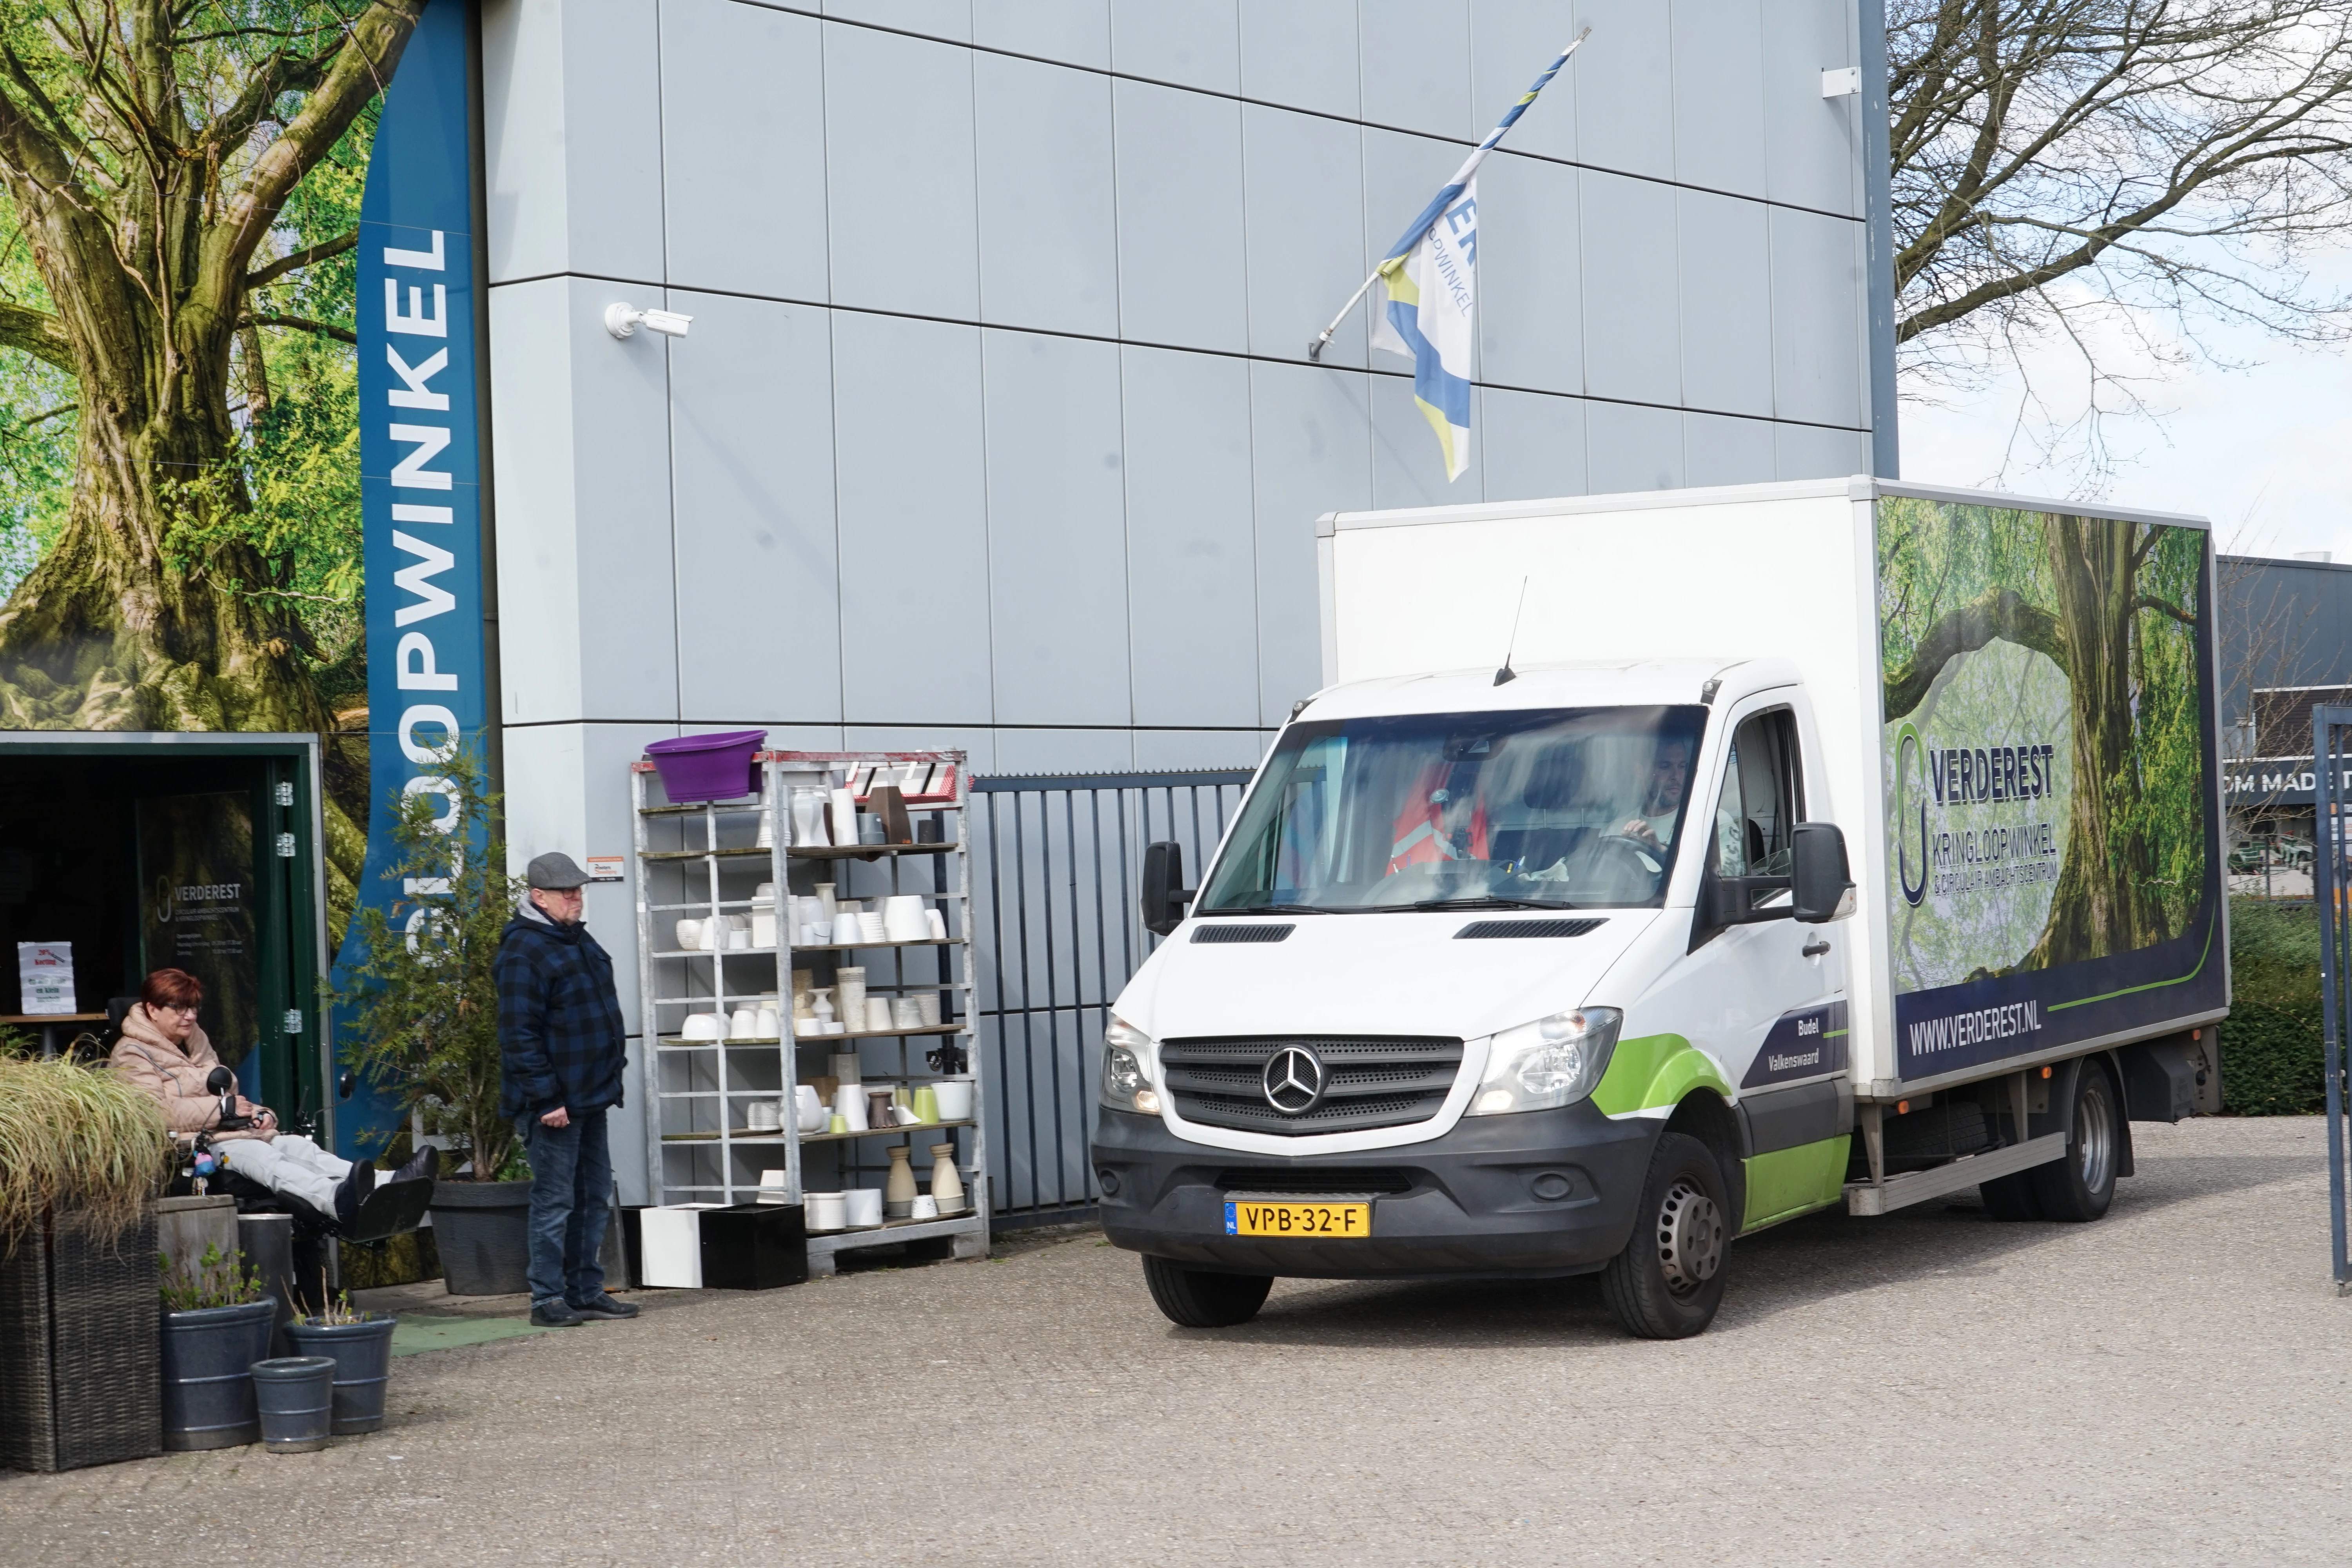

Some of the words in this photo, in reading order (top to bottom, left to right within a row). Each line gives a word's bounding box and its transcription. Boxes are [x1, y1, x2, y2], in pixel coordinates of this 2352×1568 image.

[1929, 744, 2053, 806] VERDEREST
[1932, 823, 2057, 868] KRINGLOOPWINKEL
[1941, 869, 1983, 894] CIRCULAIR
[1984, 860, 2058, 890] AMBACHTSCENTRUM
[174, 884, 241, 901] VERDEREST
[1798, 1017, 1819, 1036] Budel
[1909, 1000, 2042, 1056] WWW.VERDEREST.NL
[1768, 1047, 1819, 1072] Valkenswaard
[1227, 1221, 1236, 1229] NL
[1245, 1207, 1357, 1232] VPB-32-F
